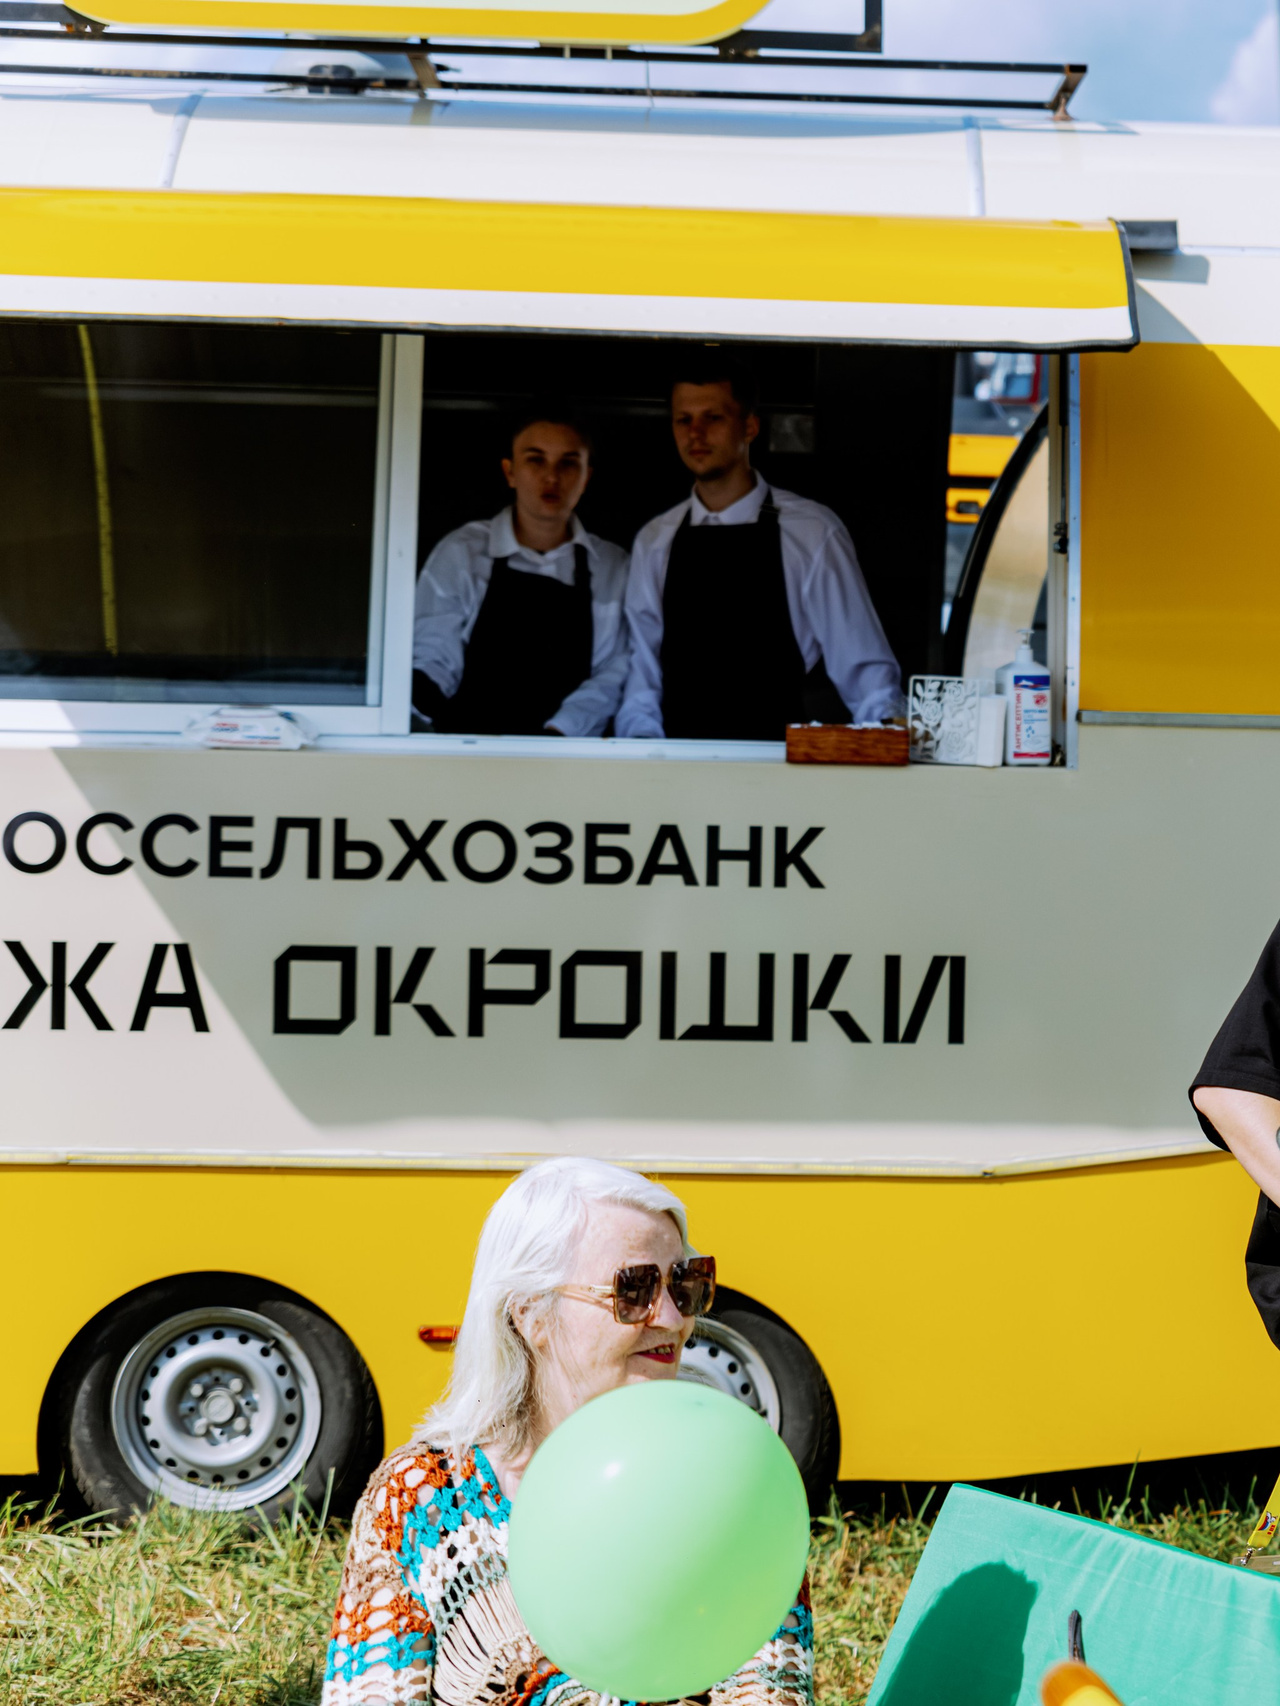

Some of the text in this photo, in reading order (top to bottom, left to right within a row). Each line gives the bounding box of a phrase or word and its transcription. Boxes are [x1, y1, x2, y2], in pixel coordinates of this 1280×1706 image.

[2, 811, 826, 889] ОССЕЛЬХОЗБАНК
[1, 940, 967, 1045] ЖА ОКРОШКИ
